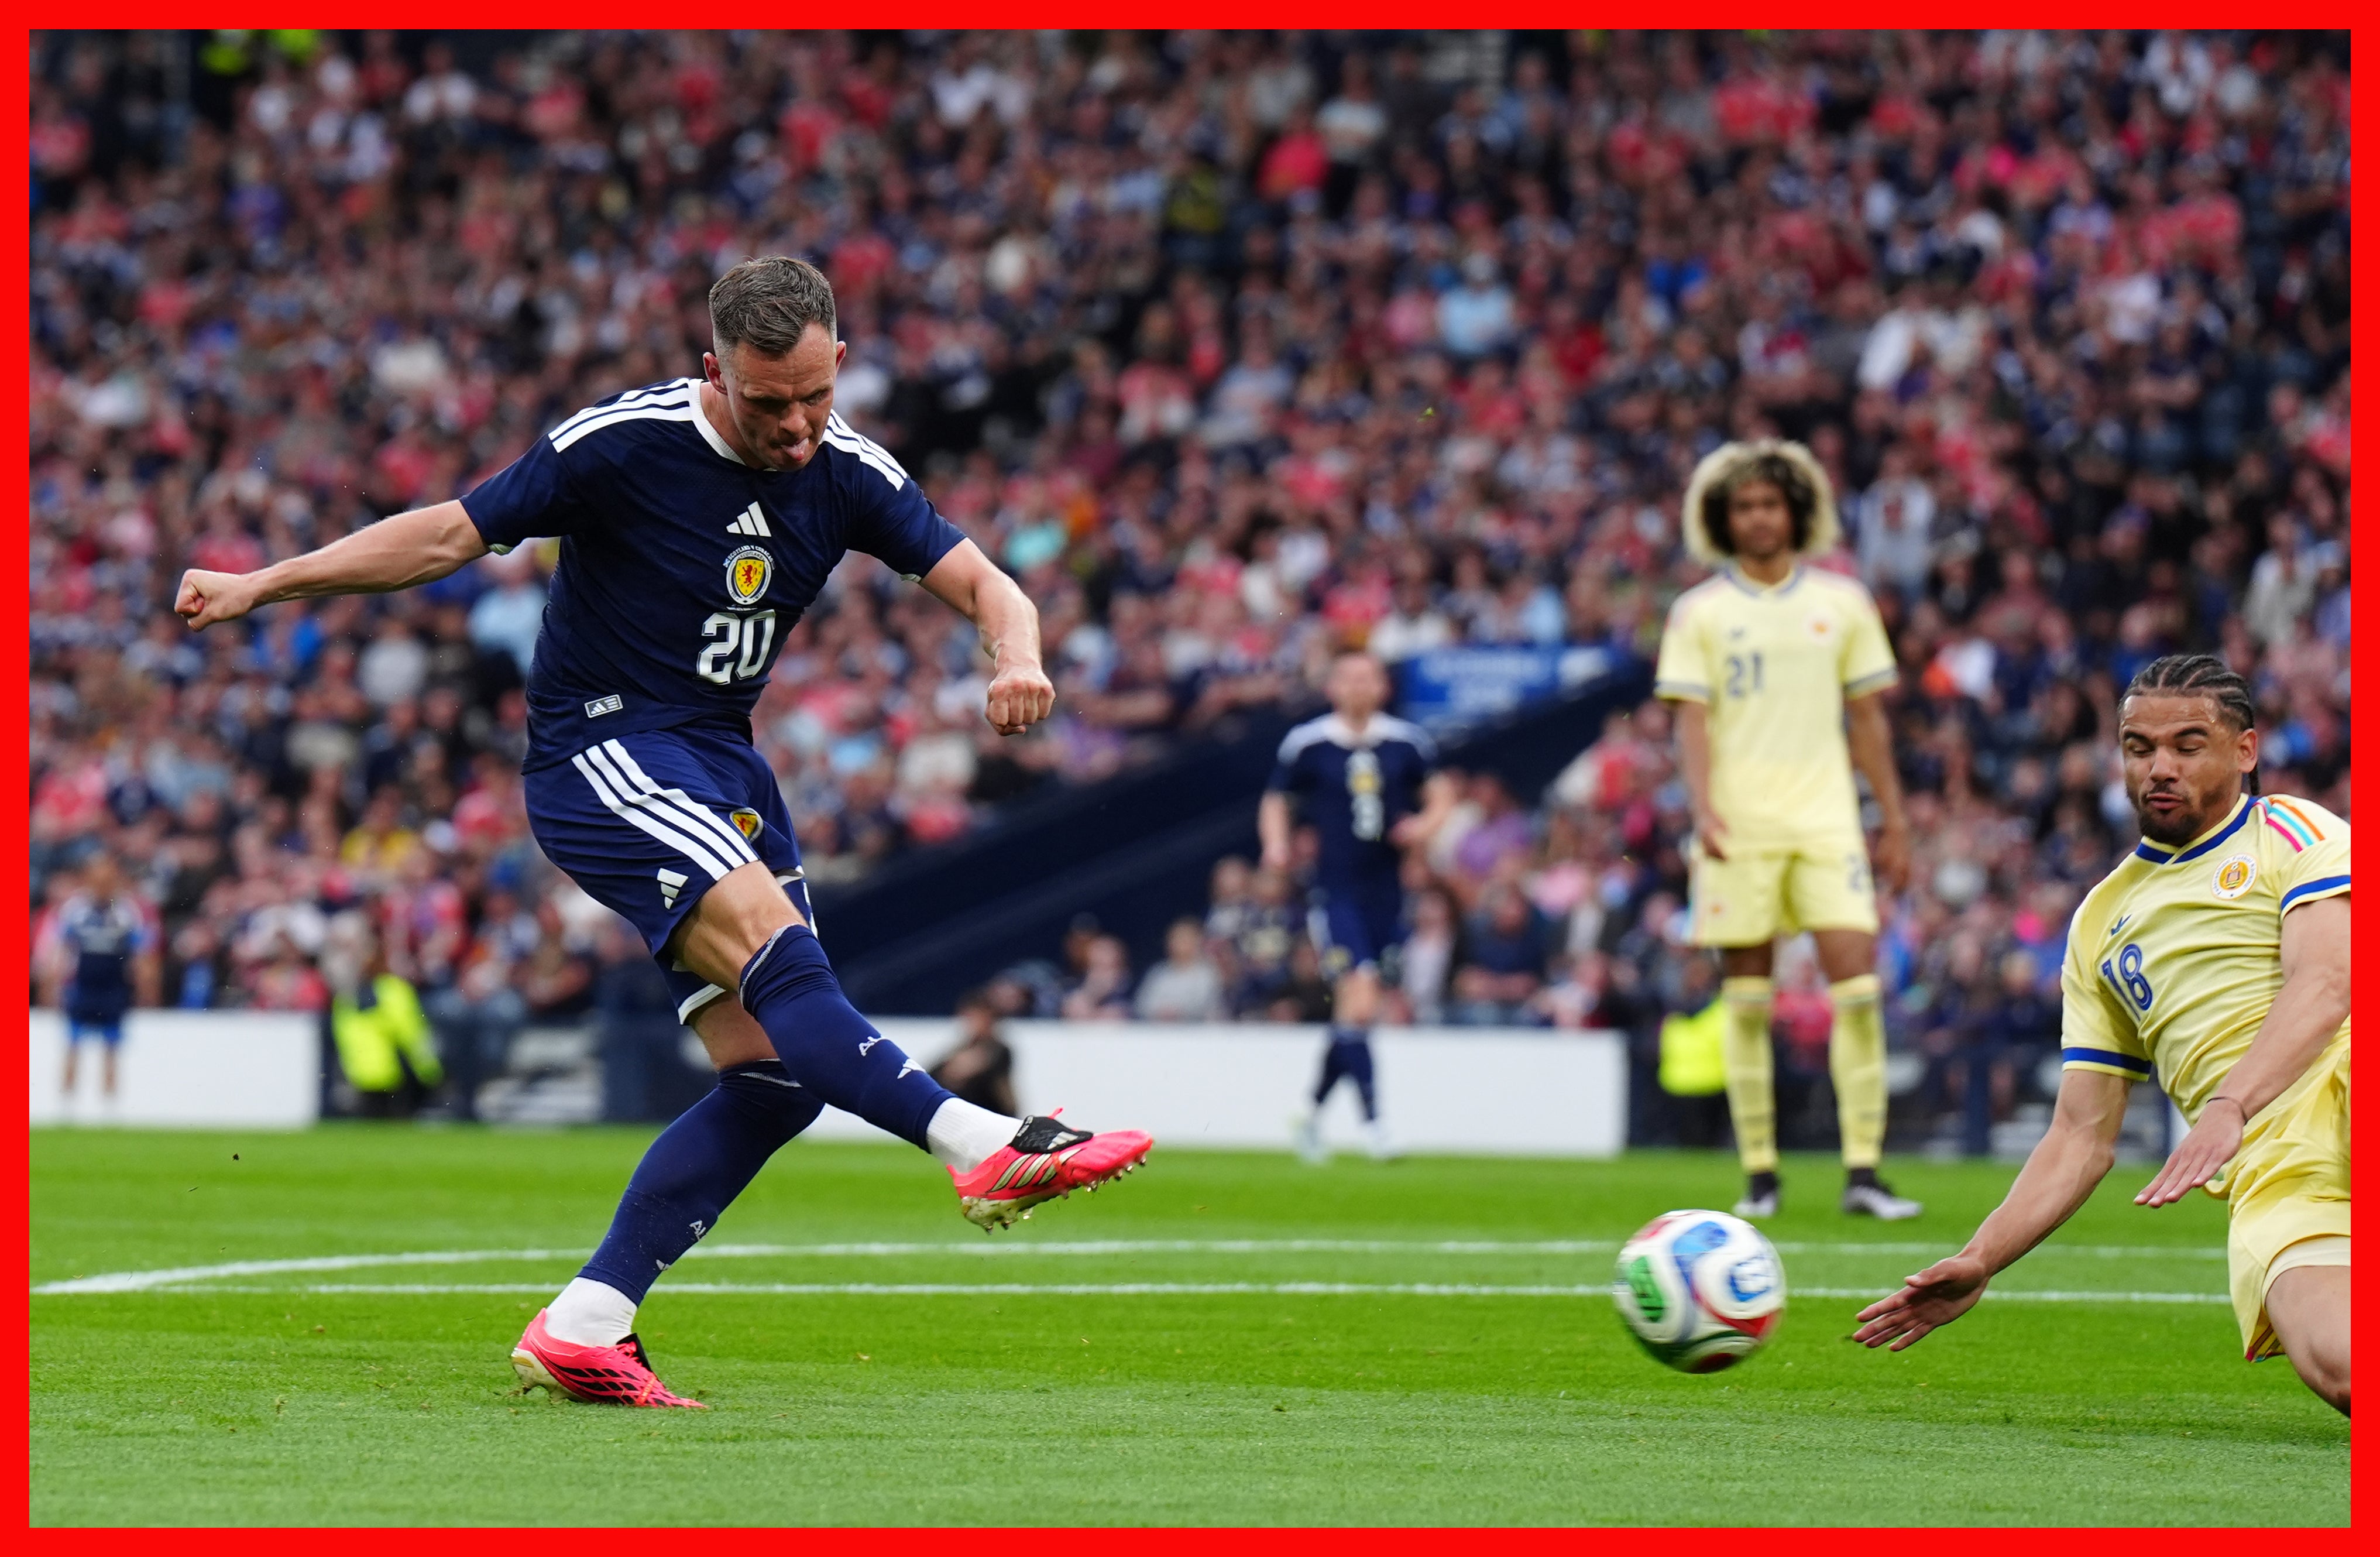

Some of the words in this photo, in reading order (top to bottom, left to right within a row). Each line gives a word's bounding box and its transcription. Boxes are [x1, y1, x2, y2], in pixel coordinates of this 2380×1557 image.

[696, 609, 776, 685] 20
[1726, 653, 1763, 699] 21
[2101, 944, 2153, 1022] 18
[858, 1035, 887, 1057] AL
[689, 1220, 706, 1240] AL
